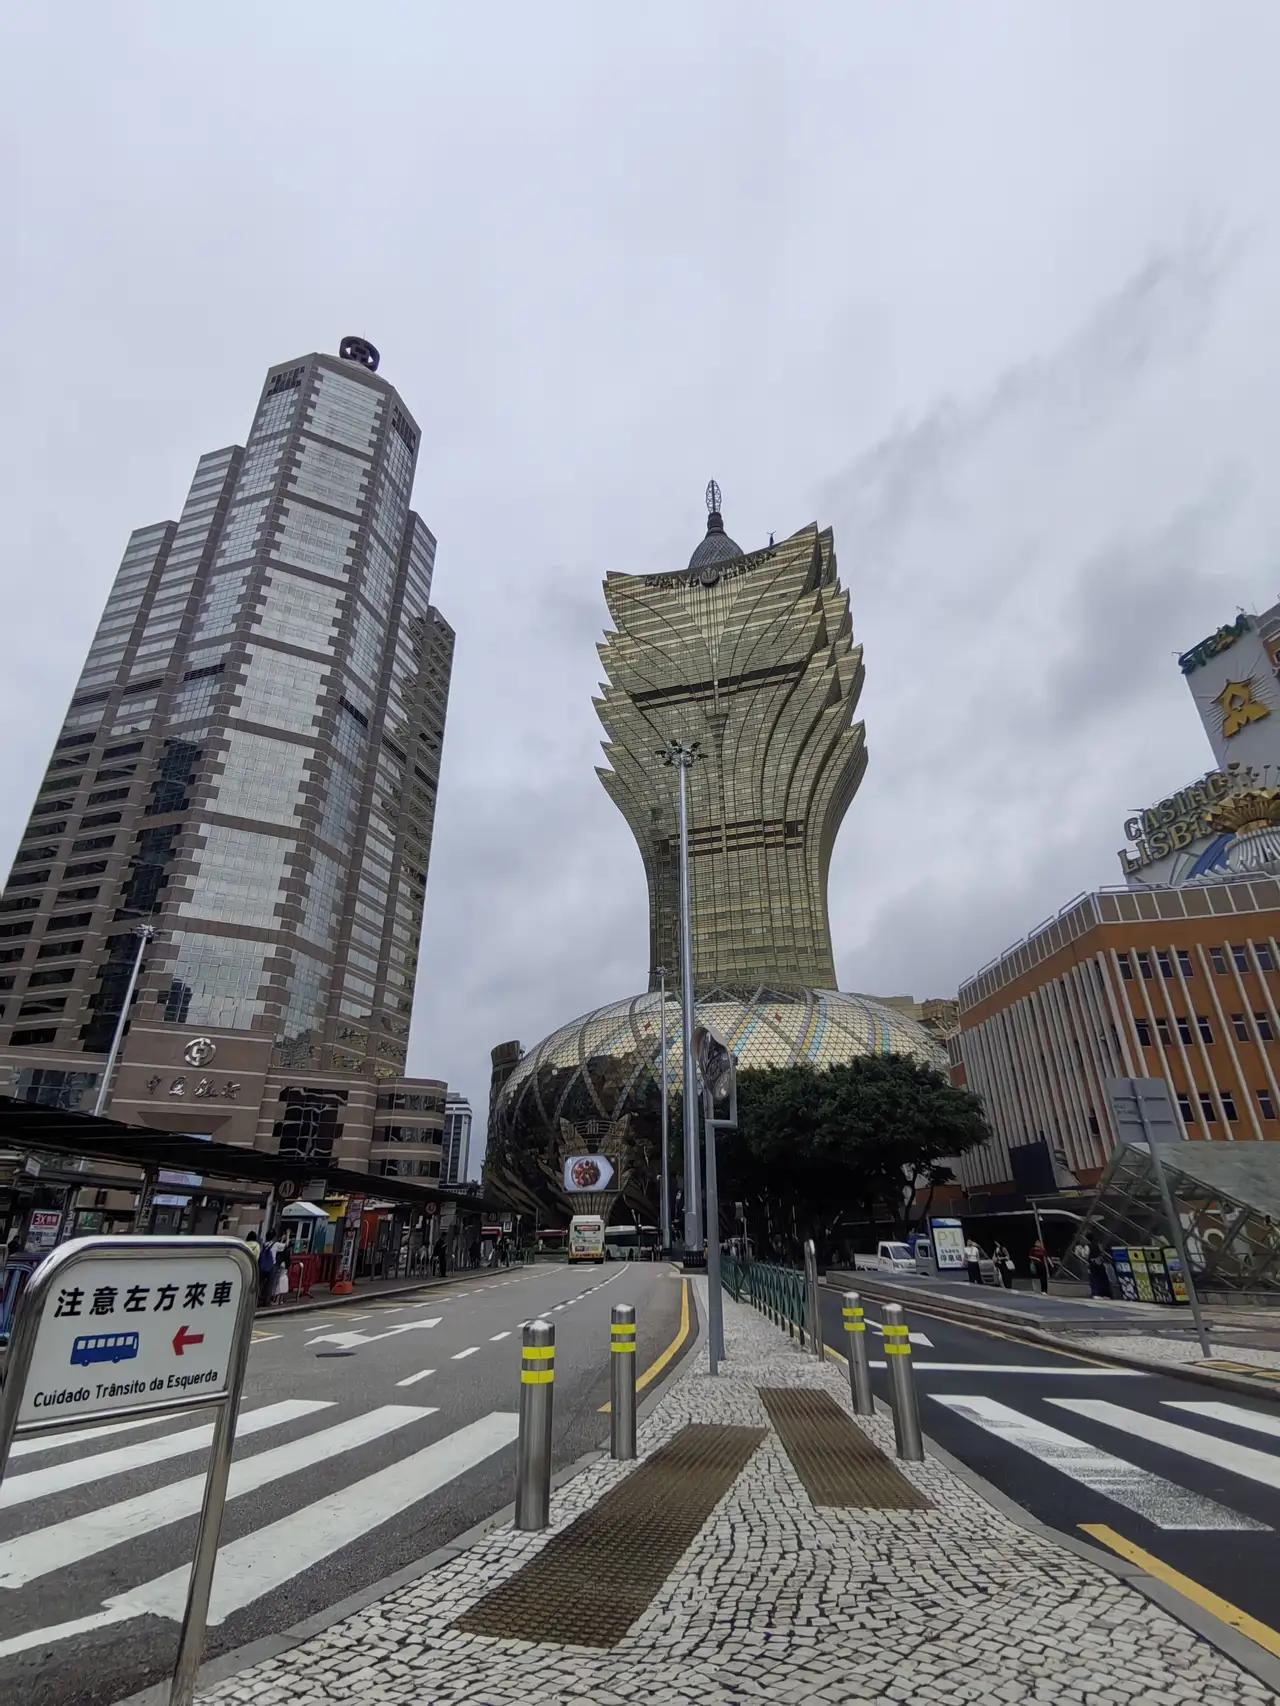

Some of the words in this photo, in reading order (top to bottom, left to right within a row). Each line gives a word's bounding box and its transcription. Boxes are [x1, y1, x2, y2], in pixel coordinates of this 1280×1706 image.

[54, 1280, 234, 1318] 注意左方來車
[33, 1389, 90, 1408] Cuidado
[96, 1378, 146, 1399] Trânsito
[149, 1377, 164, 1391] da
[167, 1369, 218, 1390] Esquerda
